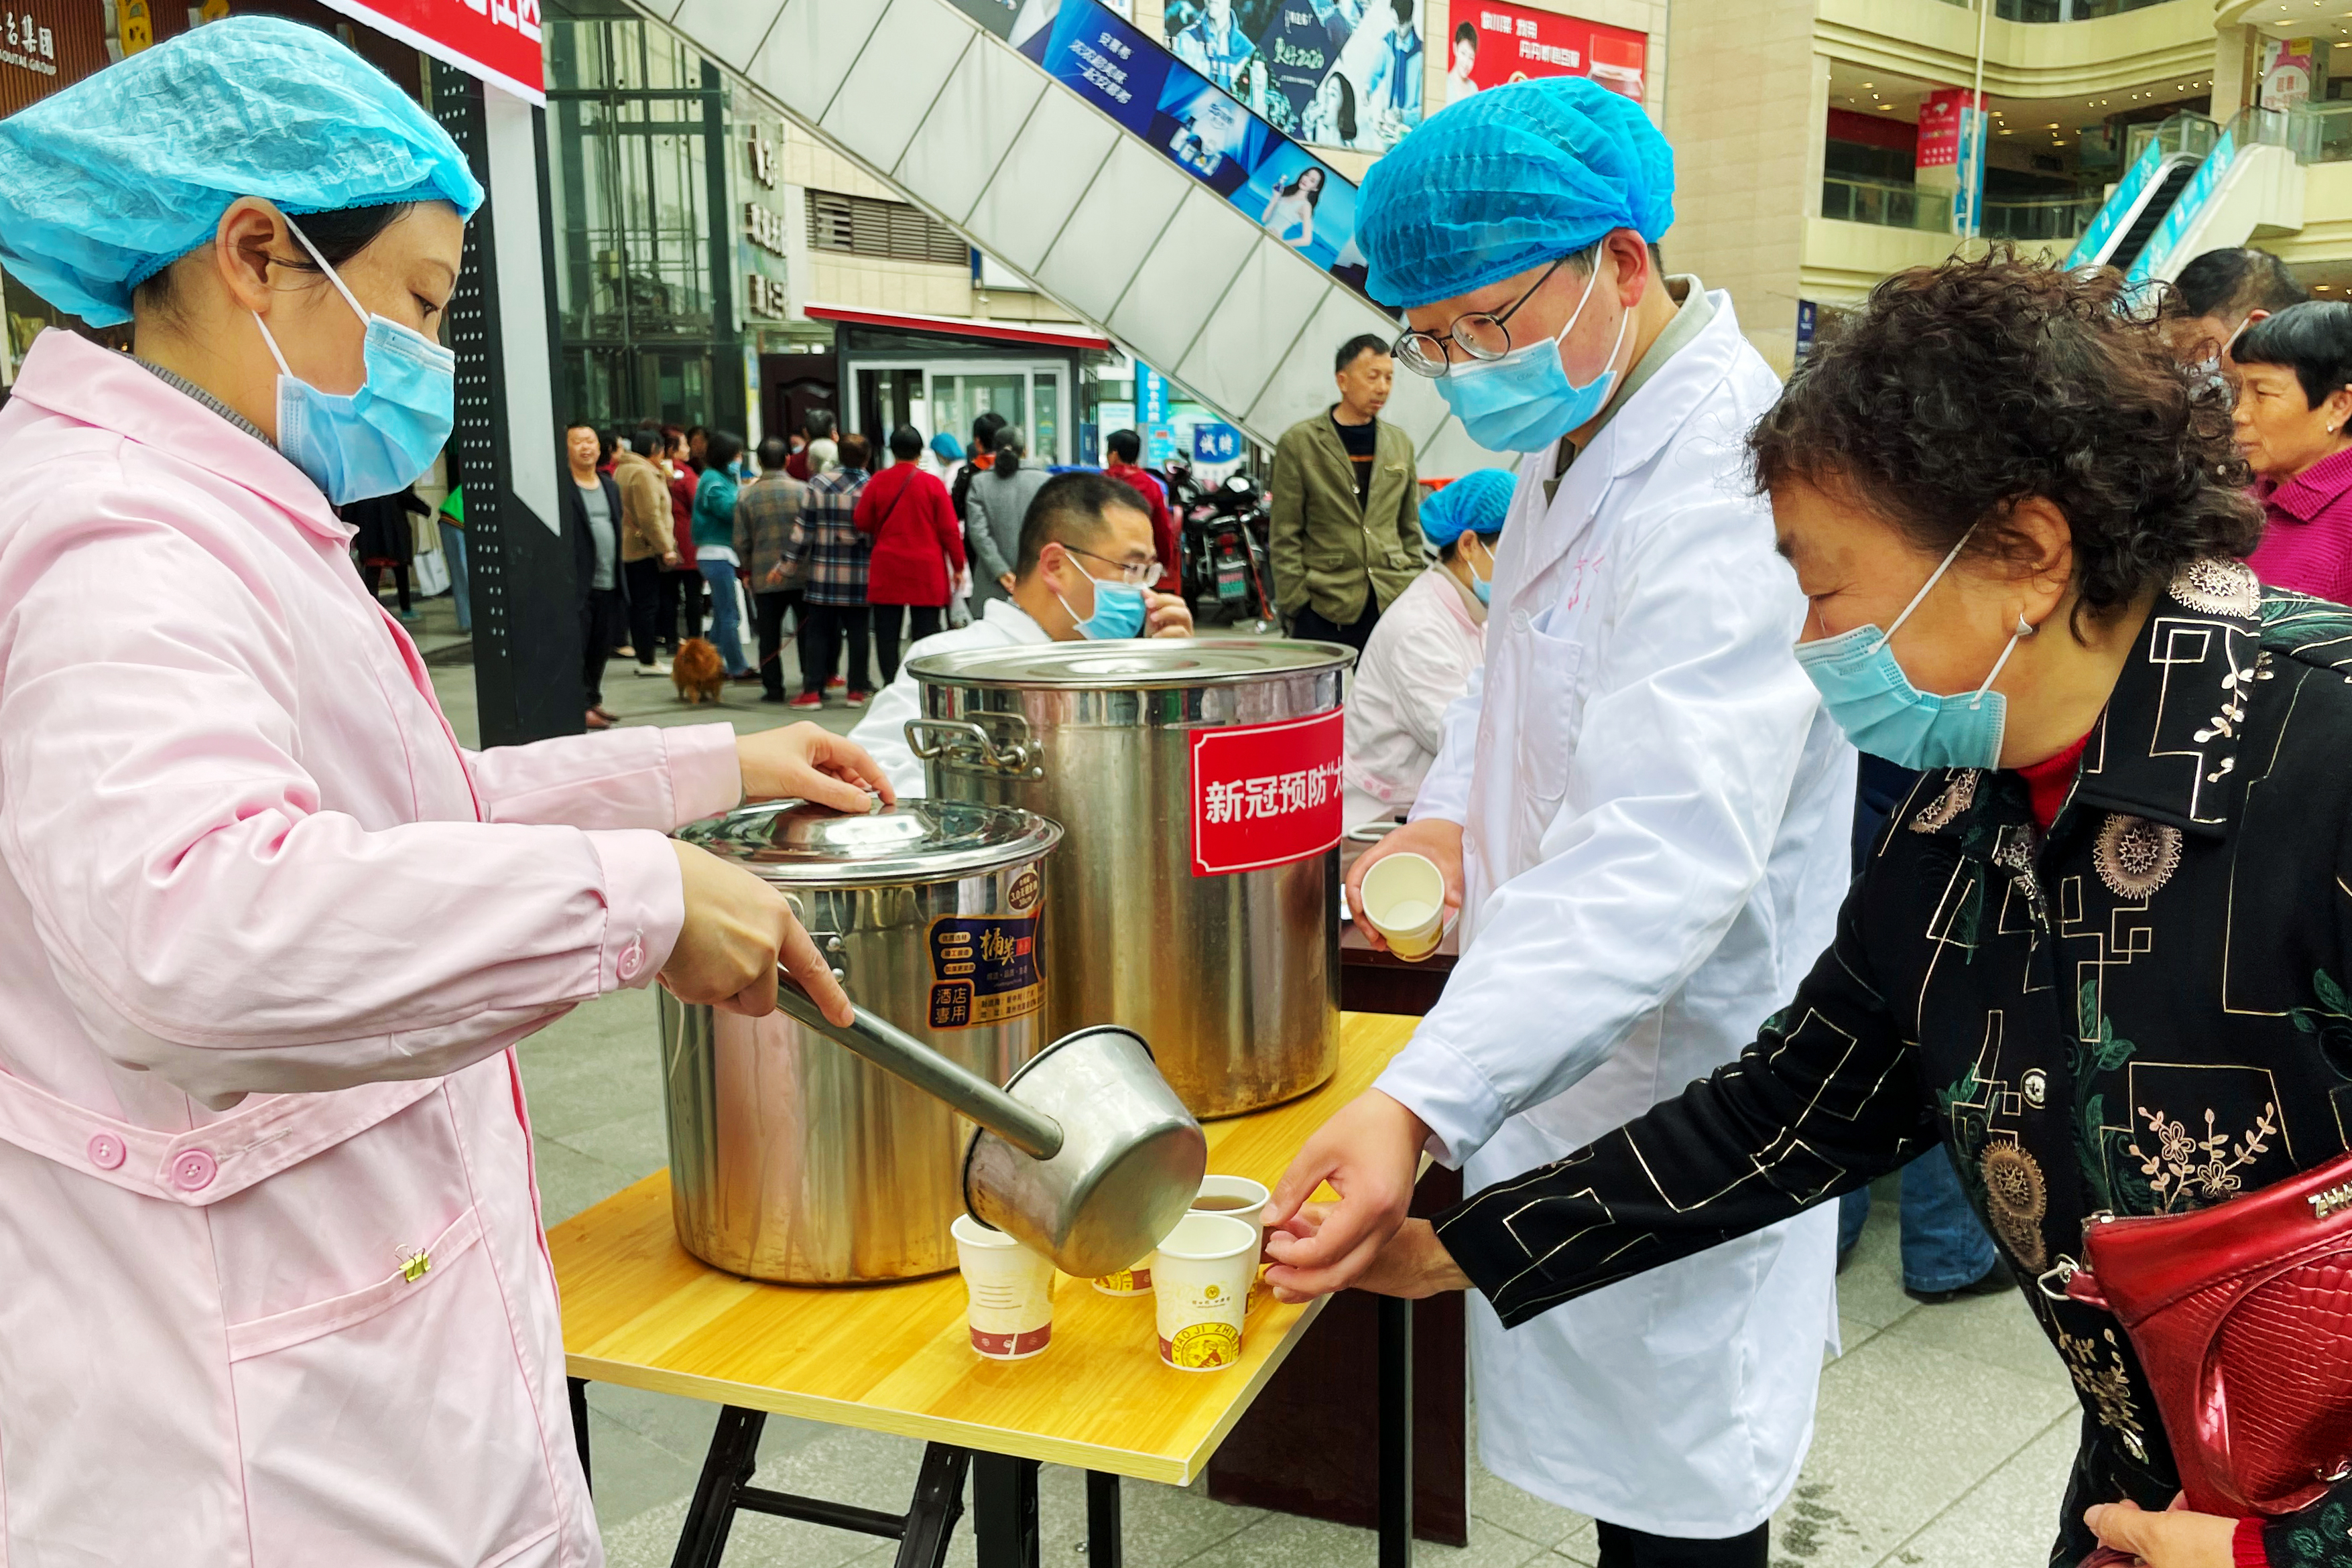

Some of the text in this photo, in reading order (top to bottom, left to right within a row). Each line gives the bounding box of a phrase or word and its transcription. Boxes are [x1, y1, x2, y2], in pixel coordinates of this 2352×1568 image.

[0, 11, 54, 60] 台集团
[0, 49, 27, 68] OUTAI
[936, 987, 967, 1004] 酒店
[1173, 1331, 1190, 1352] GAO
[1194, 1325, 1205, 1335] JI
